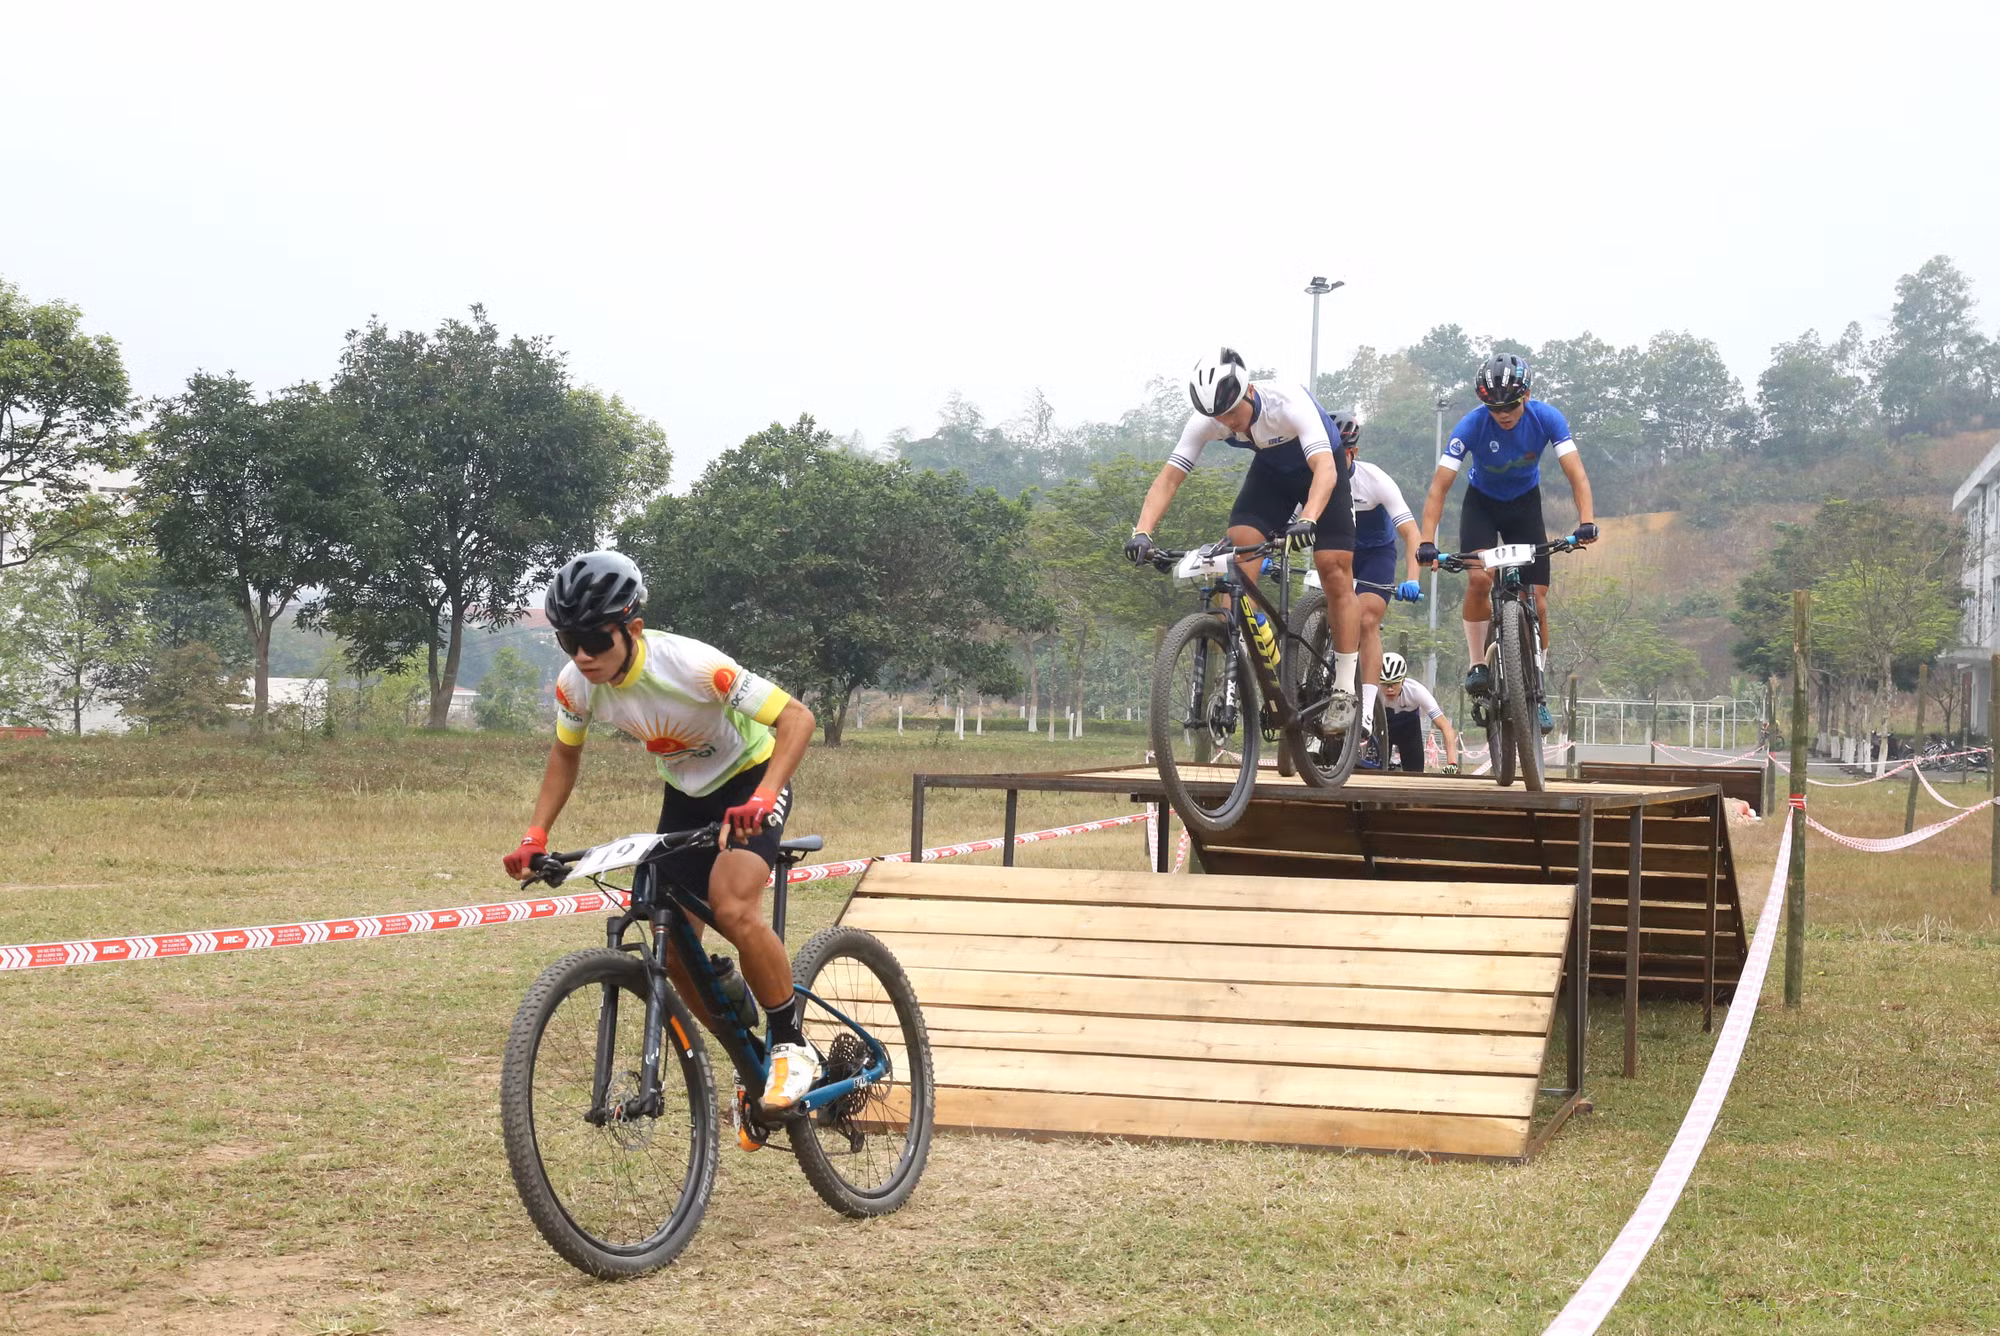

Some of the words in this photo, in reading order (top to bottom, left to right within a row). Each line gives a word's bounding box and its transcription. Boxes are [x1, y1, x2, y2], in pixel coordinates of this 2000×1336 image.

[1494, 546, 1517, 560] 01
[1240, 595, 1281, 688] SCOTT
[1226, 680, 1236, 706] FOX
[699, 1138, 716, 1206] ROCKET
